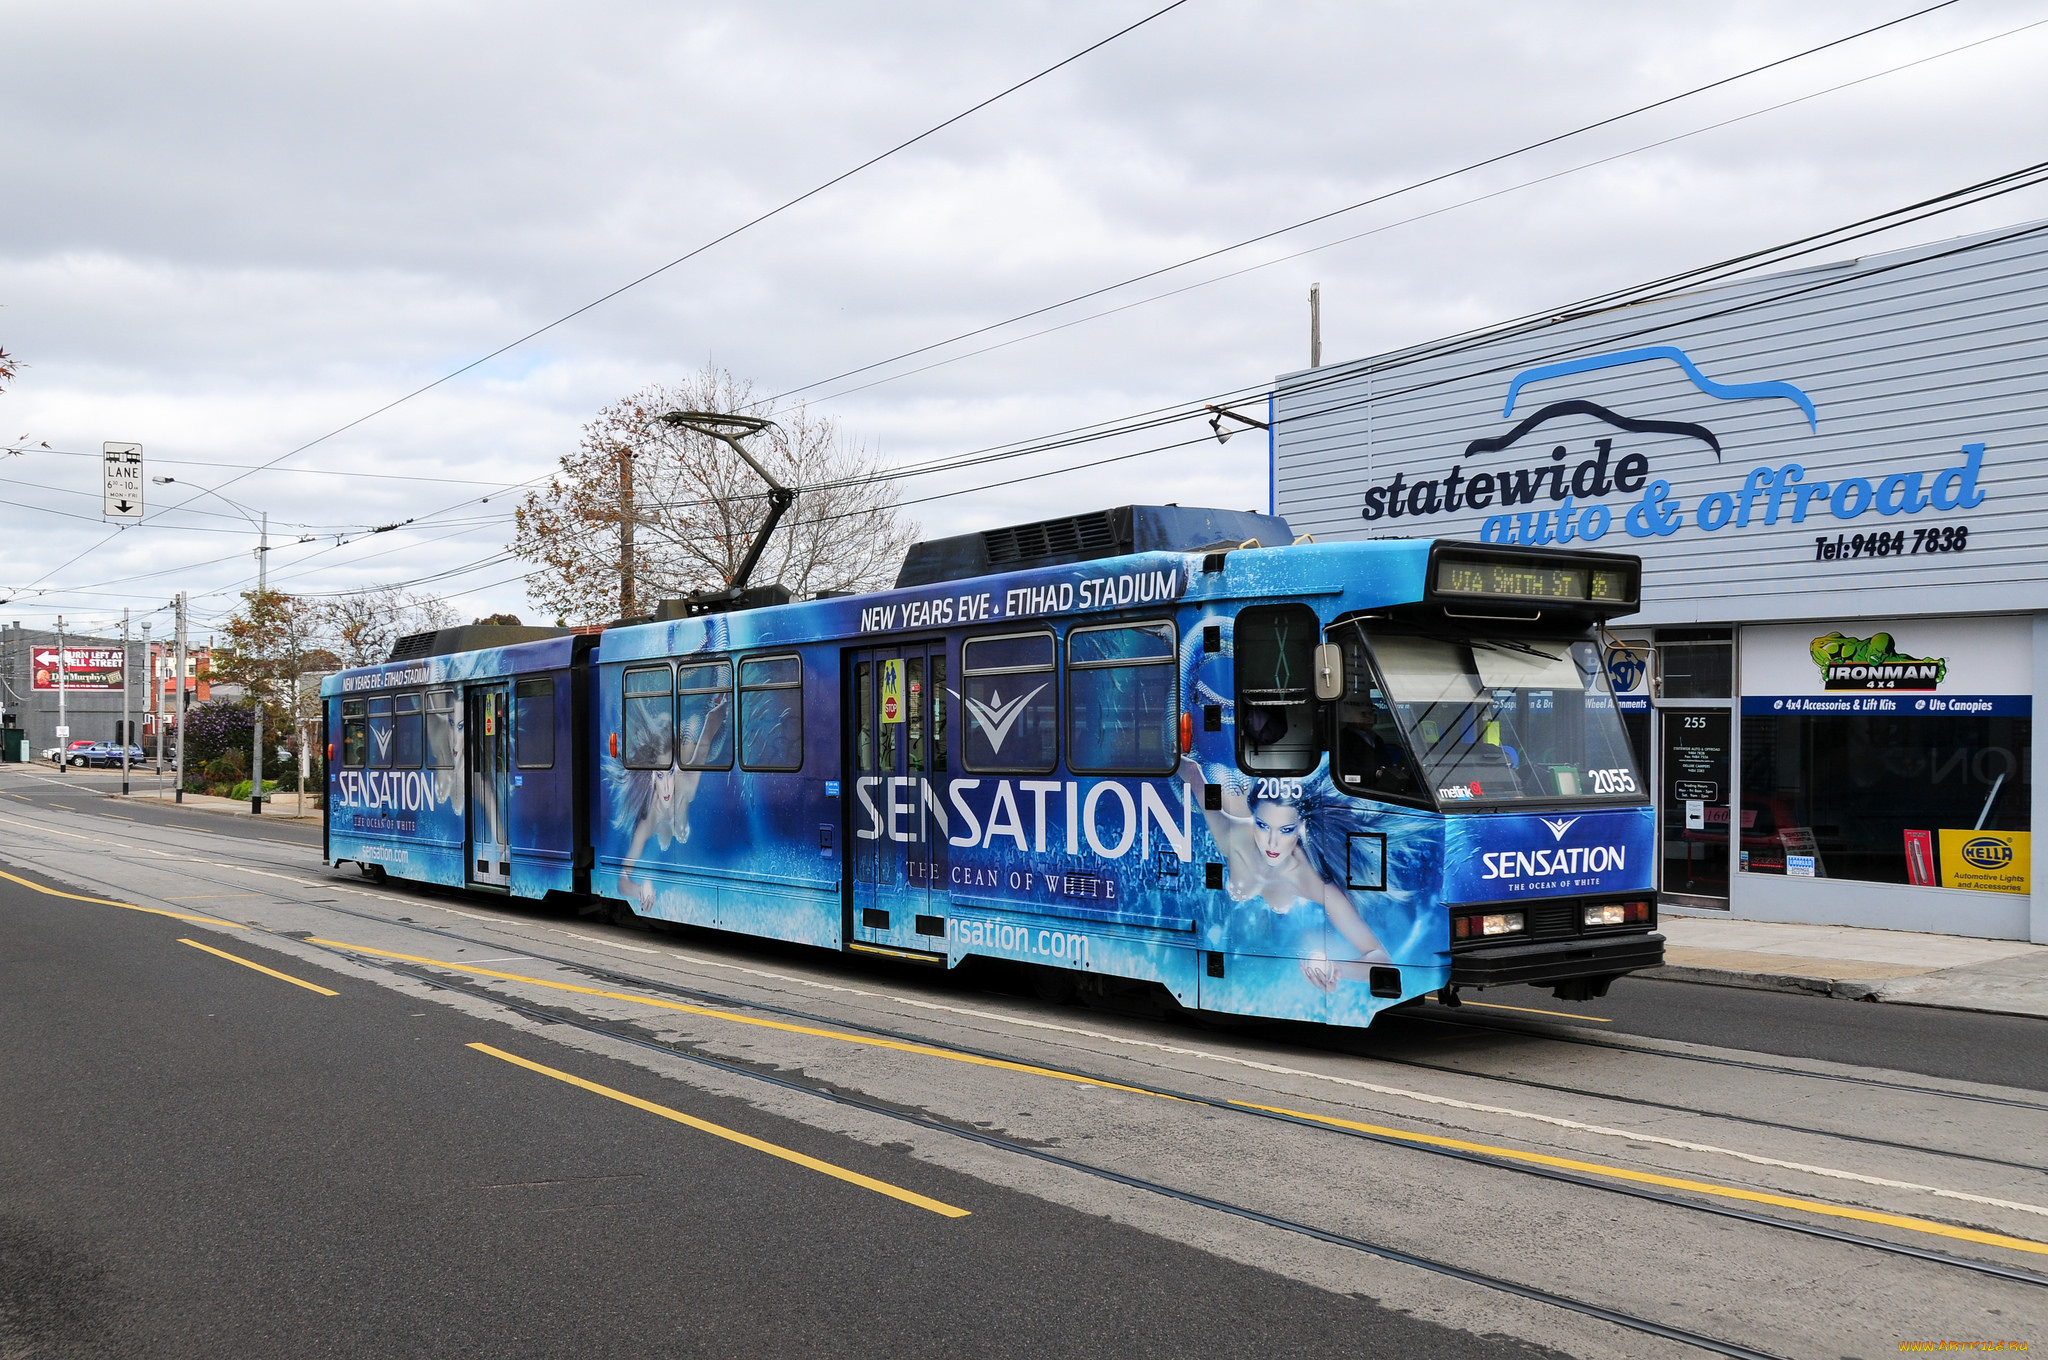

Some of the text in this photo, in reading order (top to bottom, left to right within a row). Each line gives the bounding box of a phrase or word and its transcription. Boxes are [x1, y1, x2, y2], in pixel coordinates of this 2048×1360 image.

[108, 466, 138, 478] LANE
[1363, 440, 1649, 522] statewide
[1480, 443, 1986, 546] auto & offroad
[1814, 525, 1968, 561] Tel:9484 7838
[1452, 566, 1572, 596] VIA SMITH ST
[860, 569, 1177, 632] NEW YEARS EVE ETIHAD STADIUM
[52, 672, 68, 680] Dn
[70, 672, 106, 682] Murphy's
[343, 667, 430, 691] NEW YEARS EVE ETIHAD STADIUM
[1829, 666, 1937, 680] IRONMAN
[885, 704, 897, 713] STOP
[1585, 698, 1606, 709] Wheel
[1786, 699, 1896, 710] 4x4 Accessories & Lift Kits
[1929, 700, 1993, 713] Ute Canopies
[1684, 716, 1706, 728] 255
[1256, 777, 1303, 799] 2055
[1589, 768, 1636, 794] 2055
[339, 771, 435, 812] SENSATION
[1439, 784, 1471, 800] metlink
[354, 816, 416, 832] THE OCEAN OF WHITE
[856, 776, 1192, 863] SENSATION
[362, 844, 409, 864] sensation.com
[1481, 845, 1626, 880] SENSATION
[1966, 846, 2013, 861] HELLA
[906, 861, 940, 880] THE
[1010, 871, 1033, 891] OF
[1045, 874, 1116, 900] WHITE
[1528, 881, 1557, 890] OCEAN
[1560, 880, 1570, 888] OF
[1574, 878, 1600, 886] WHITE
[1954, 872, 2024, 883] Automotive Lights
[1974, 882, 2022, 891] Accessories
[938, 915, 1089, 961] nsation.com
